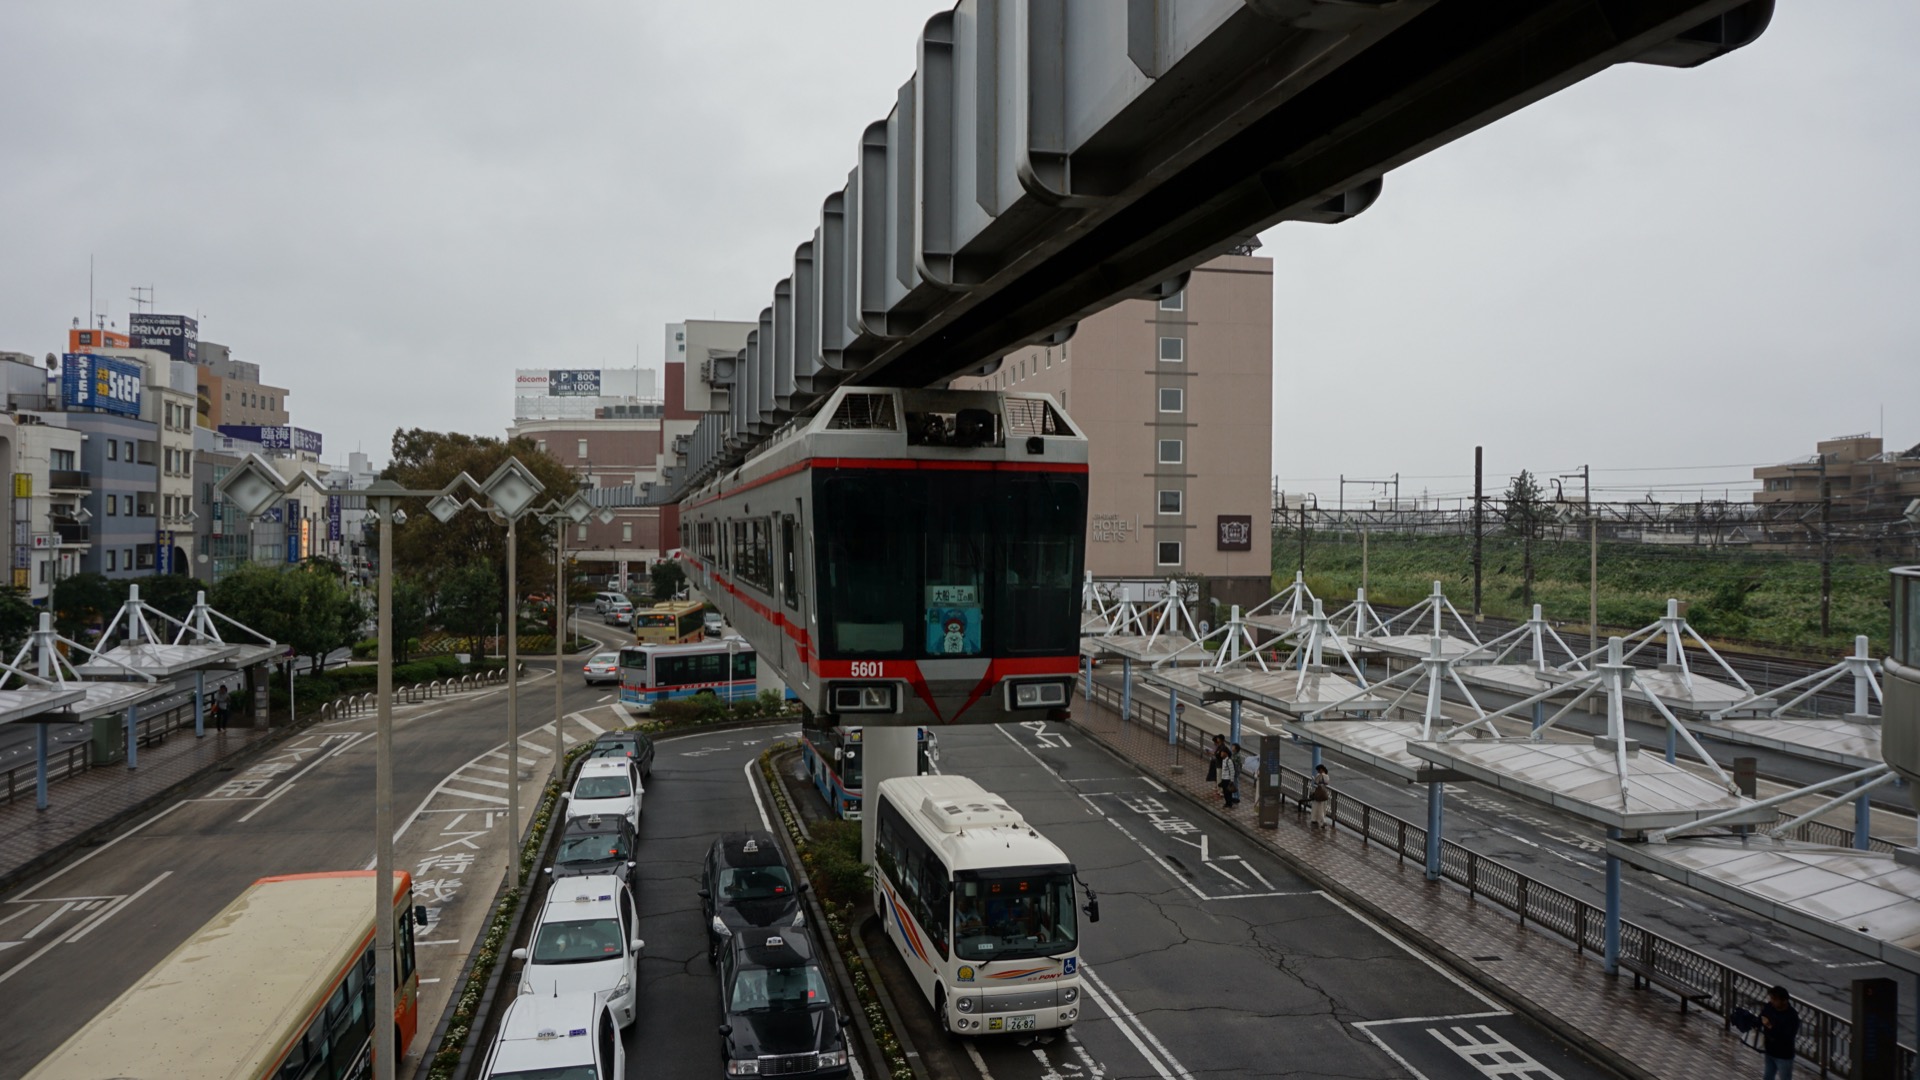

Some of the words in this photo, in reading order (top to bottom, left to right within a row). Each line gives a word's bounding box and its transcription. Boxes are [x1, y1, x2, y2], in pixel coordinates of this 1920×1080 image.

[131, 325, 182, 336] PRIVATO
[560, 373, 569, 382] P
[261, 427, 289, 440] 臨海
[262, 440, 289, 448] セミナー
[1092, 519, 1133, 531] HOTEL
[1092, 530, 1126, 542] METS
[851, 661, 883, 677] 5601
[1039, 972, 1062, 980] PONY
